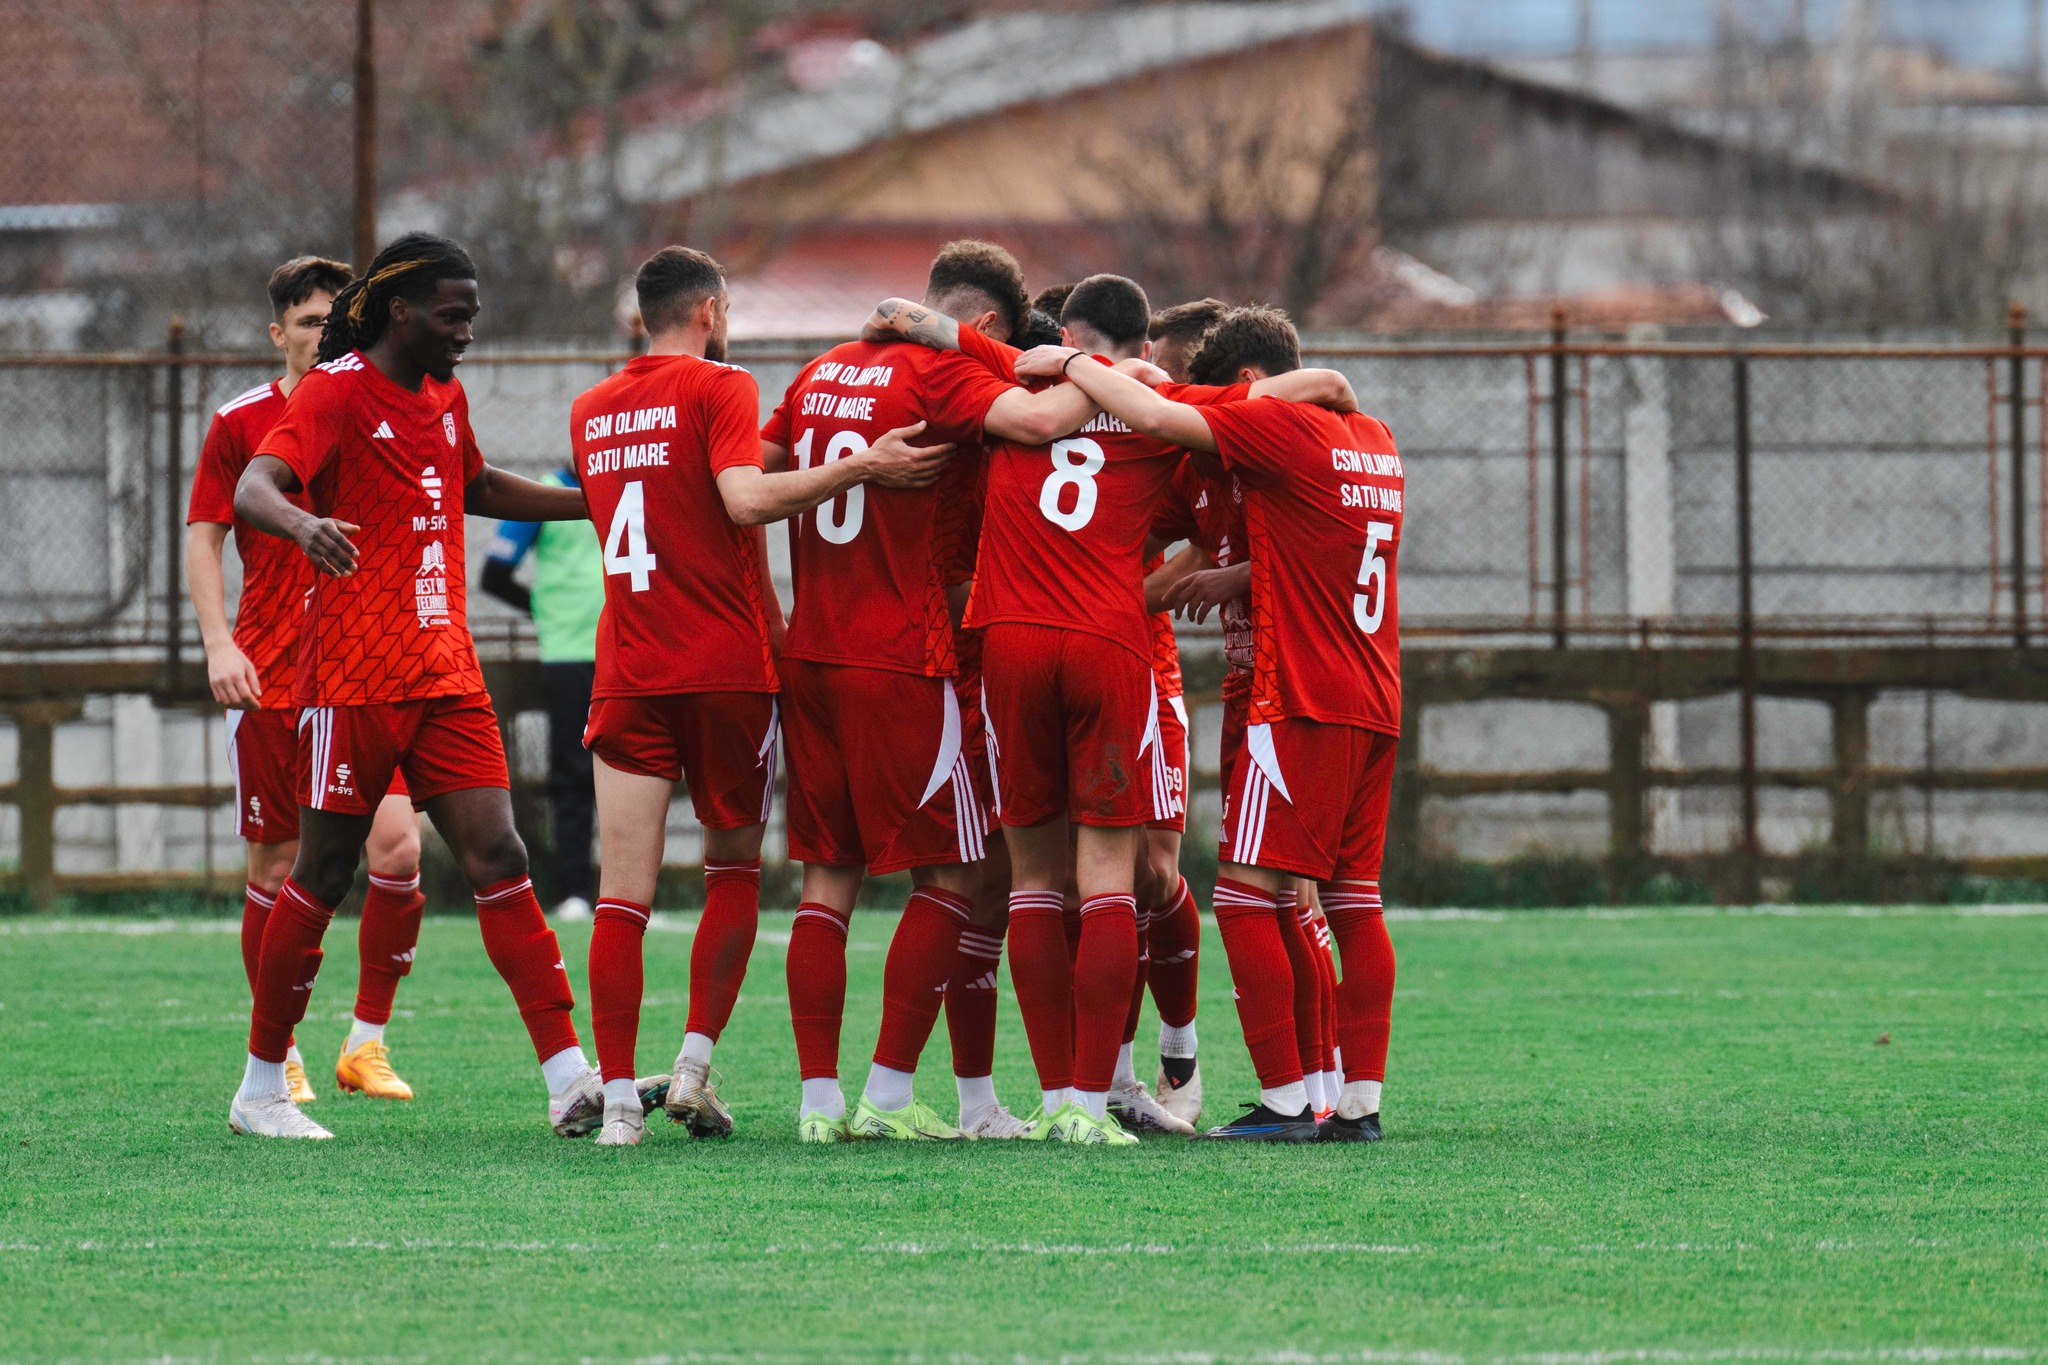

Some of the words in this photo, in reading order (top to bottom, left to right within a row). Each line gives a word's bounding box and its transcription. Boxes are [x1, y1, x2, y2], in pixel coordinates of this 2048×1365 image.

[811, 362, 843, 382] CSM
[838, 365, 893, 387] OLIMPIA
[585, 414, 612, 442] CSM
[615, 405, 677, 434] OLIMPIA
[801, 392, 837, 416] SATU
[834, 397, 876, 421] MARE
[587, 448, 621, 476] SATU
[623, 442, 670, 469] MARE
[1332, 448, 1363, 472] CSM
[1362, 453, 1403, 478] OLIMPIA
[794, 428, 869, 545] 10
[1039, 437, 1106, 532] 8
[1340, 483, 1378, 509] SATU
[1380, 487, 1403, 513] MARE
[603, 480, 657, 592] 4
[415, 578, 435, 594] BEST
[1353, 521, 1394, 634] 5
